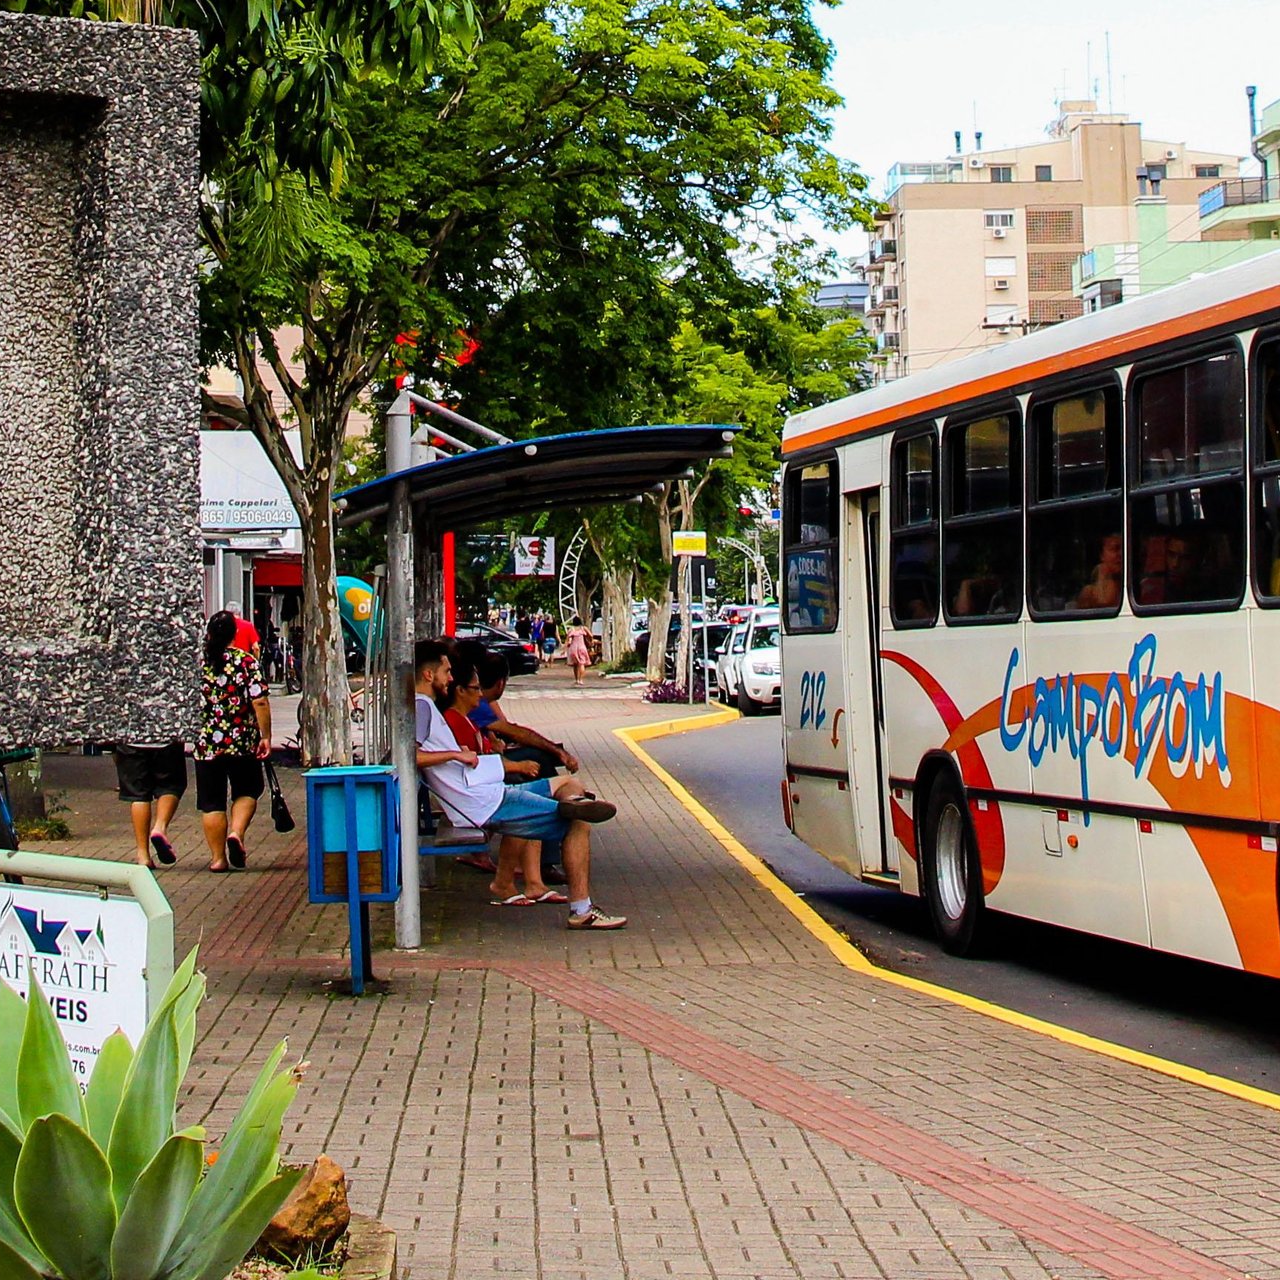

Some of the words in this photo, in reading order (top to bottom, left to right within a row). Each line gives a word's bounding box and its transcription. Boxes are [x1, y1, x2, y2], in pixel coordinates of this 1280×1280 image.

[228, 498, 278, 508] Cappelari
[233, 509, 293, 524] 9506-0449
[801, 670, 827, 730] 212
